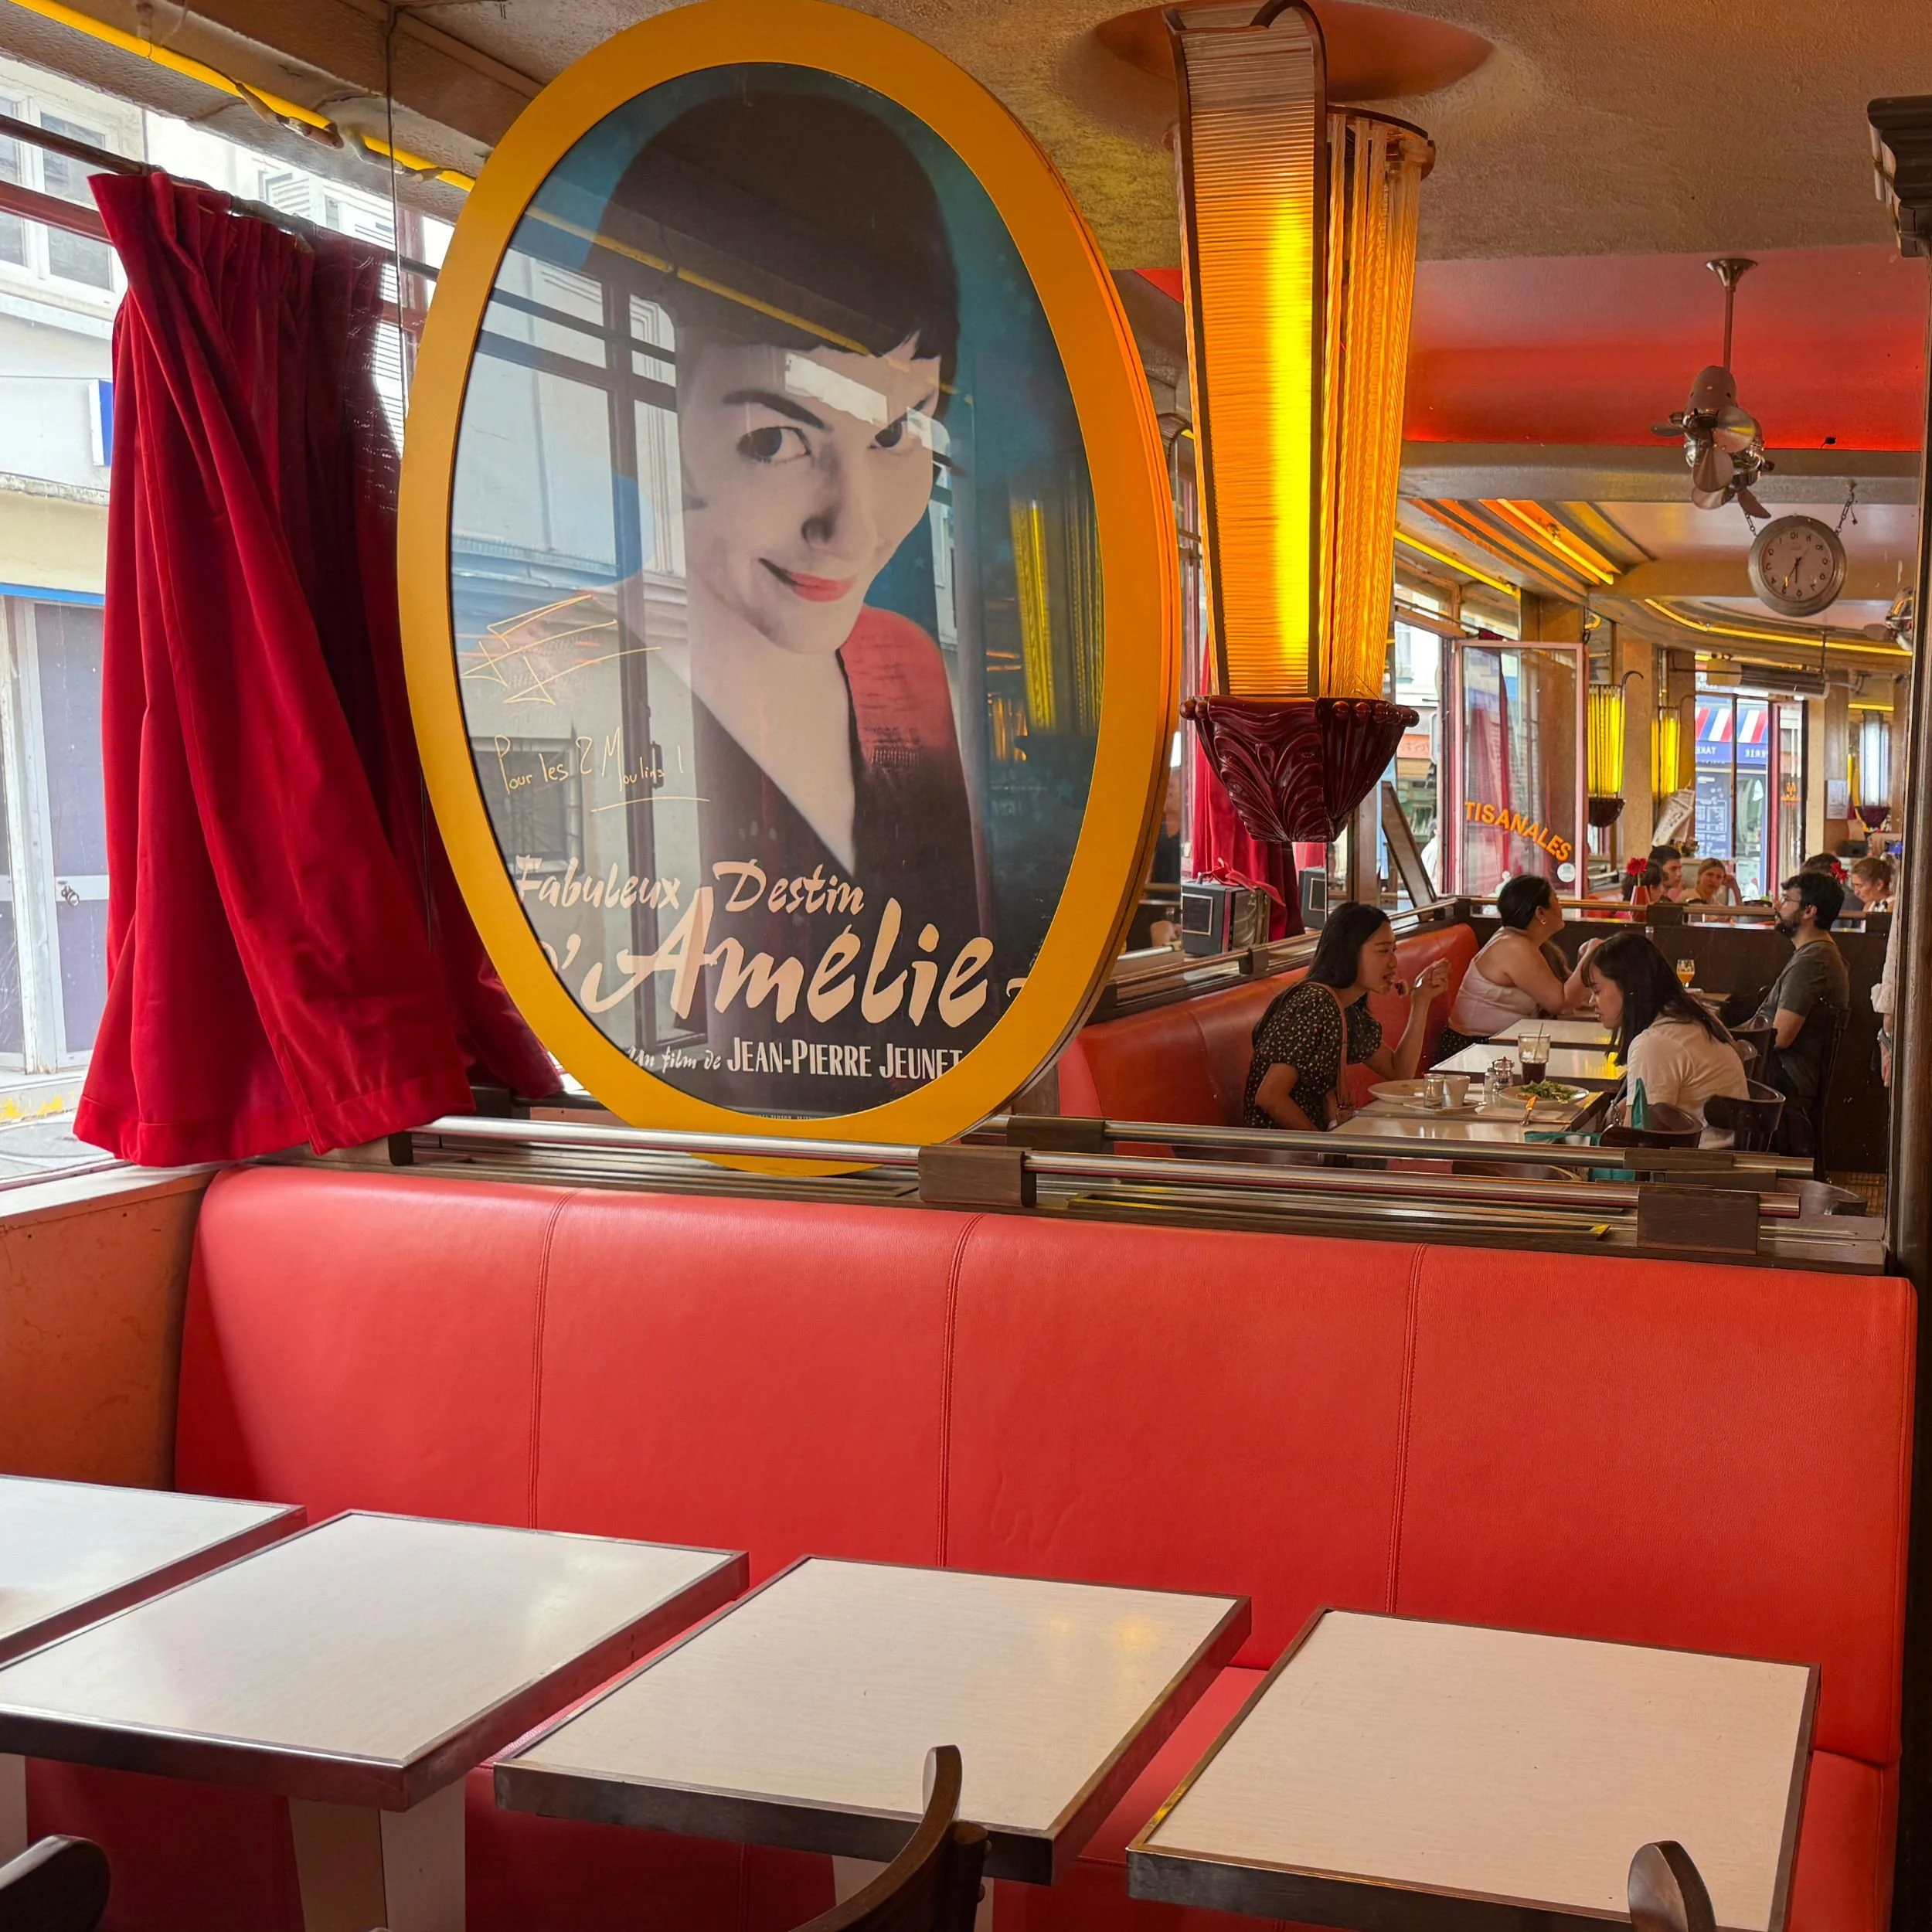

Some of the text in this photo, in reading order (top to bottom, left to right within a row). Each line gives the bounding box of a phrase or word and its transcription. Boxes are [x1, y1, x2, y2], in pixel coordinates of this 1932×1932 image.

[494, 734, 532, 795] Pour
[539, 753, 569, 782] les
[575, 736, 594, 774] 2
[1465, 801, 1572, 862] TISANALES
[515, 855, 864, 916] Fabuleux Destin
[662, 1045, 697, 1074] film
[704, 1049, 722, 1070] de
[726, 1036, 872, 1077] JEAN-PIERRE
